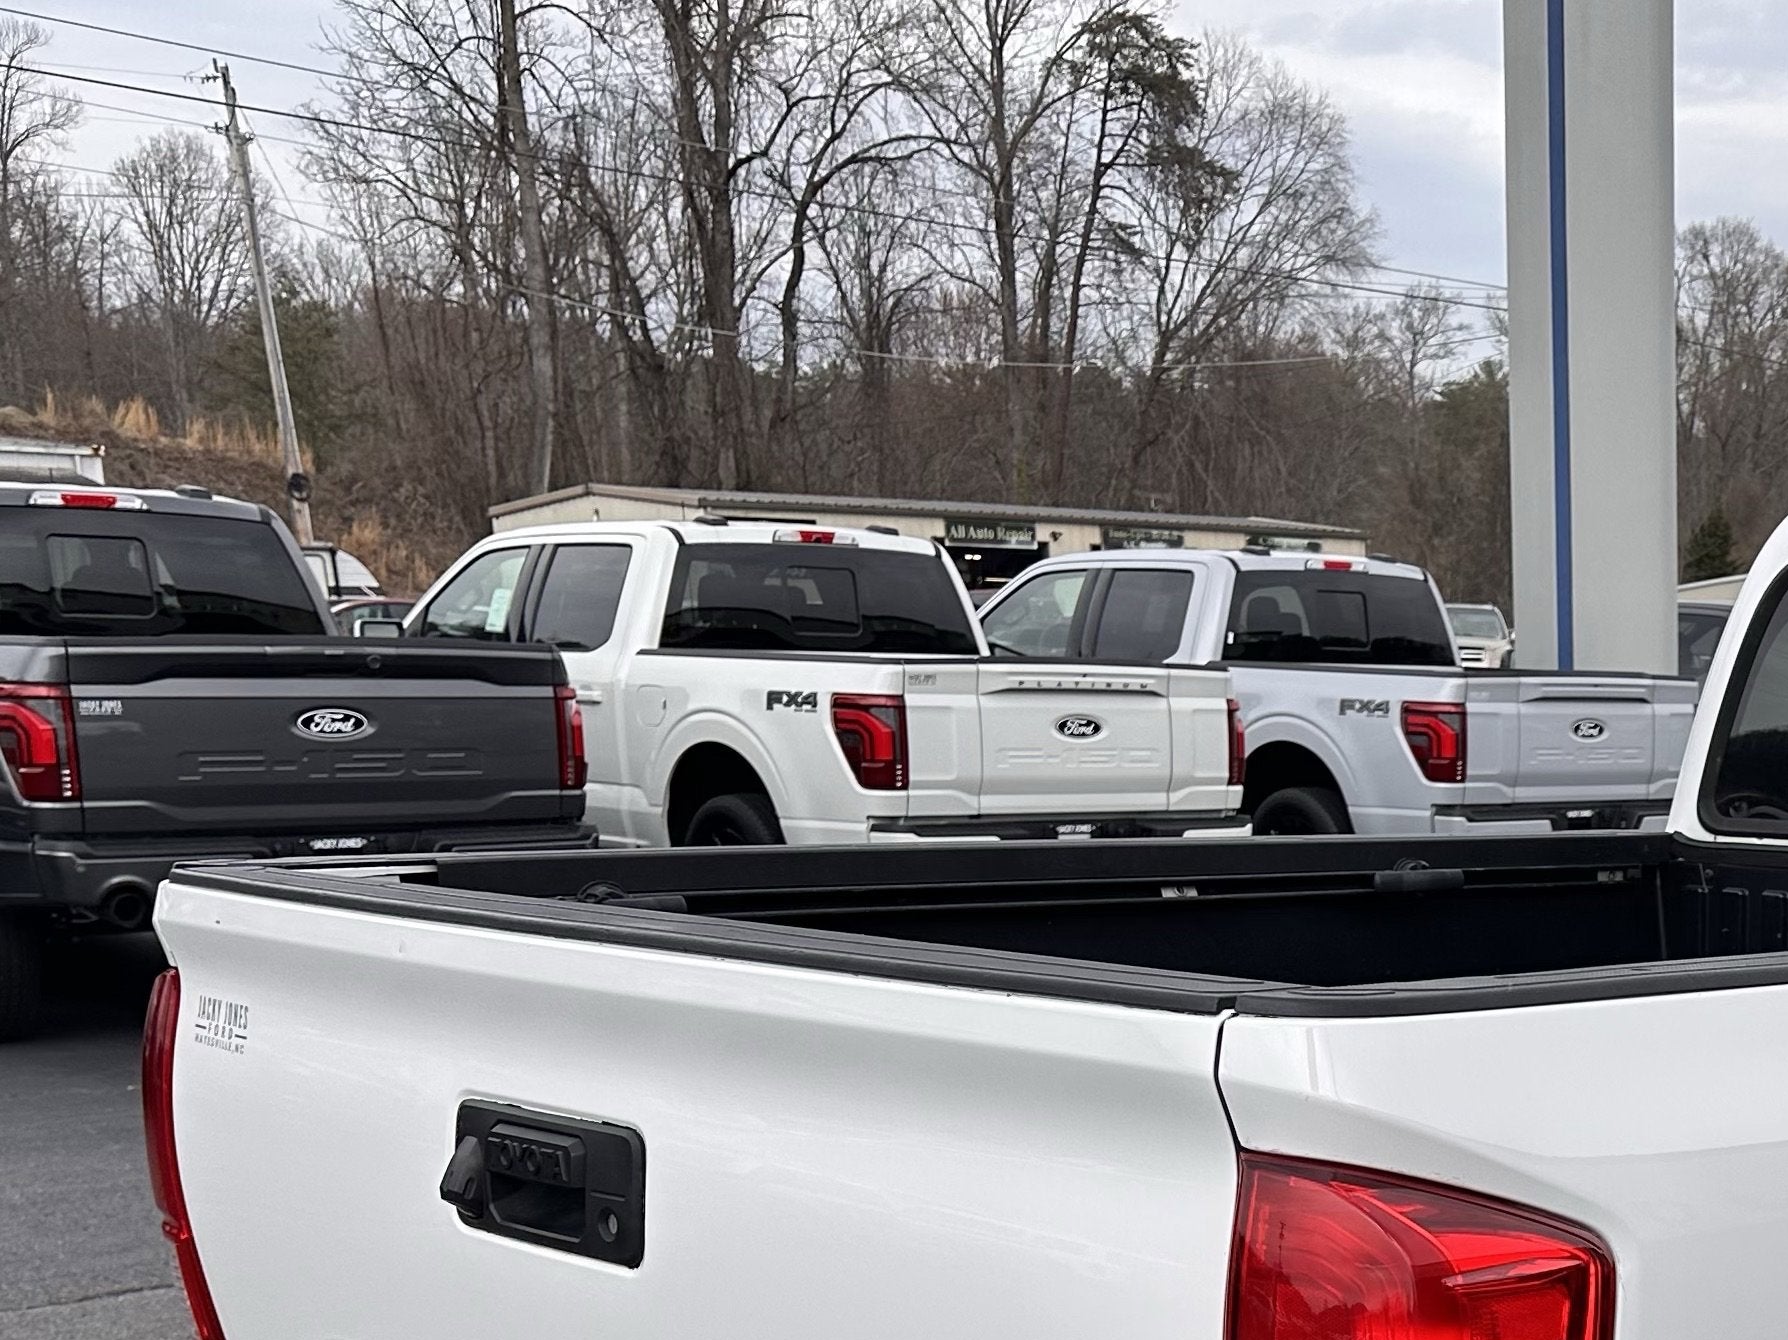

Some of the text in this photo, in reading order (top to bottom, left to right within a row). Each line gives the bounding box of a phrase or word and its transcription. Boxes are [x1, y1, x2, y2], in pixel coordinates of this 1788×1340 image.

[949, 525, 1034, 544] All Auto Repair
[1018, 680, 1148, 689] PLATINUM
[766, 690, 818, 711] FX4
[1338, 698, 1390, 716] FX4
[310, 713, 355, 733] Ford
[197, 995, 249, 1030] JACKY JONES
[208, 1022, 234, 1040] FORD
